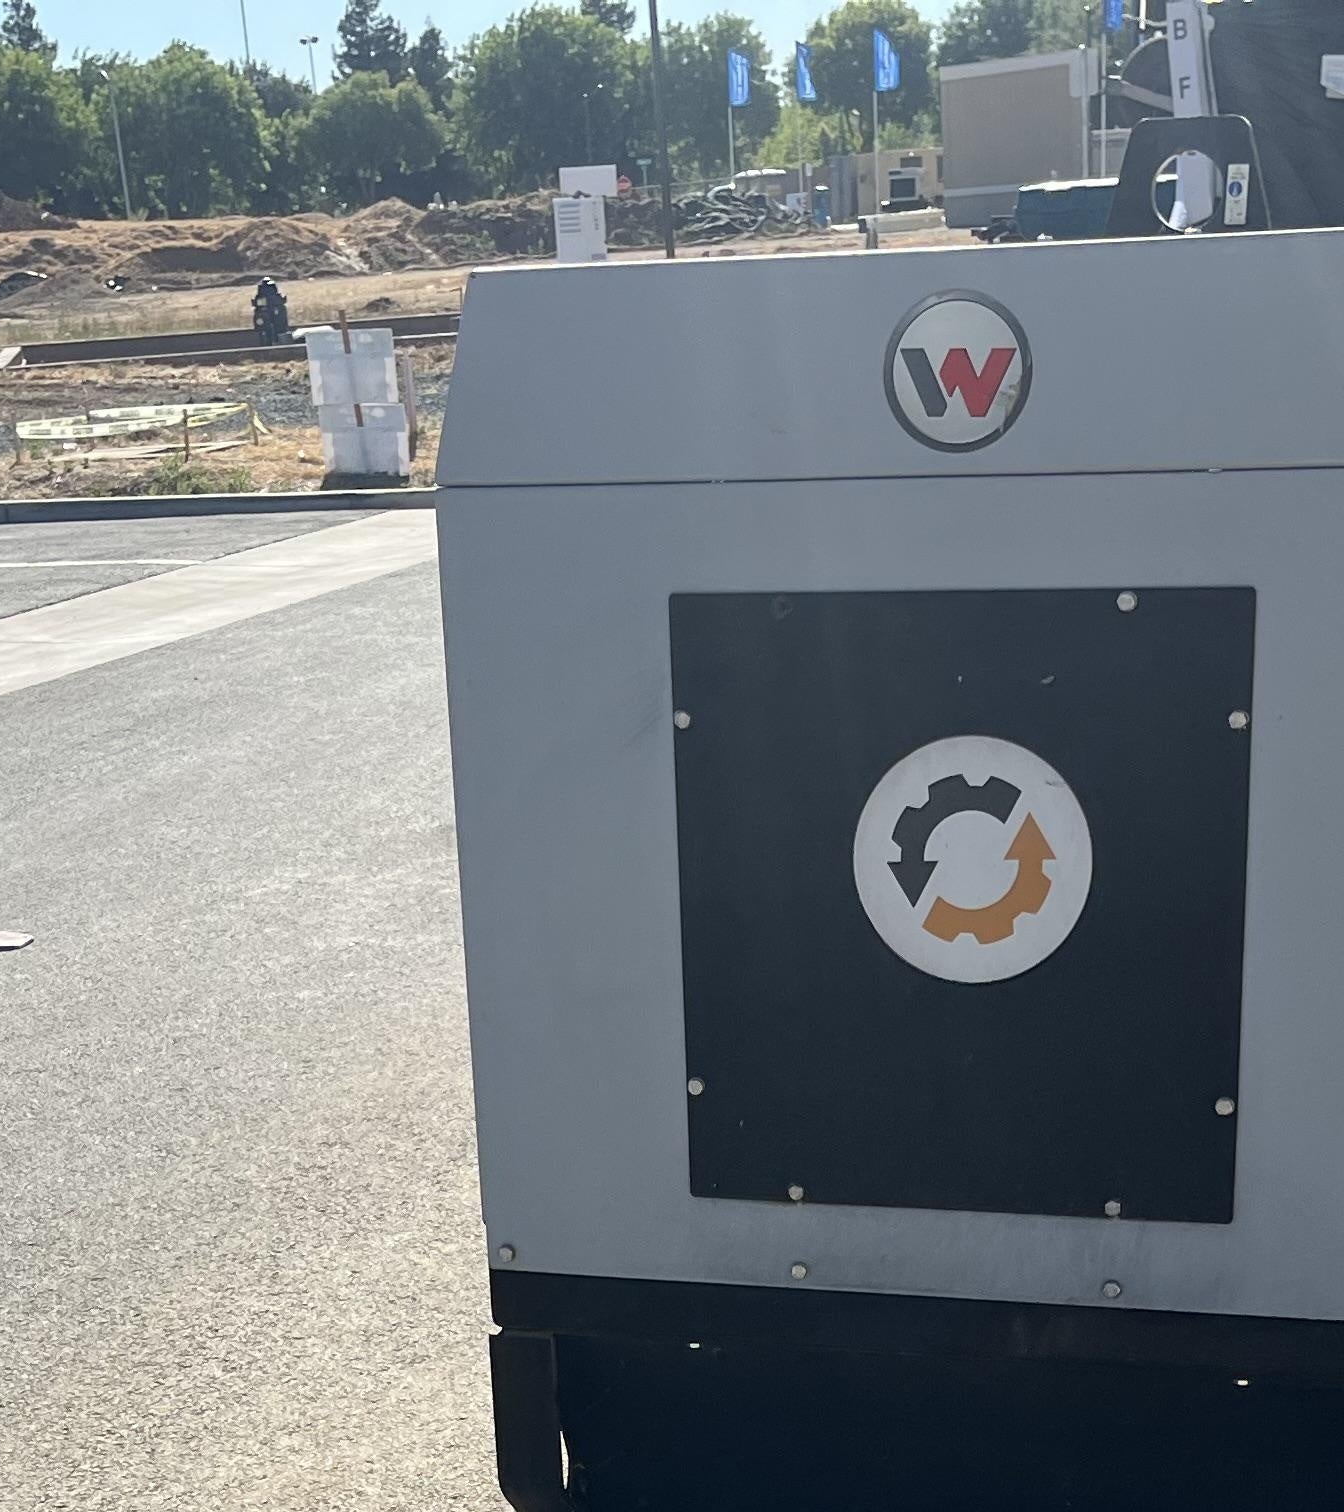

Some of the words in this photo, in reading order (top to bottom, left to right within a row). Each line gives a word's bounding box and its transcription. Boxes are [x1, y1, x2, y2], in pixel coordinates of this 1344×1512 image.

[1173, 19, 1188, 40] B
[1178, 76, 1191, 99] F
[899, 347, 1018, 418] W
